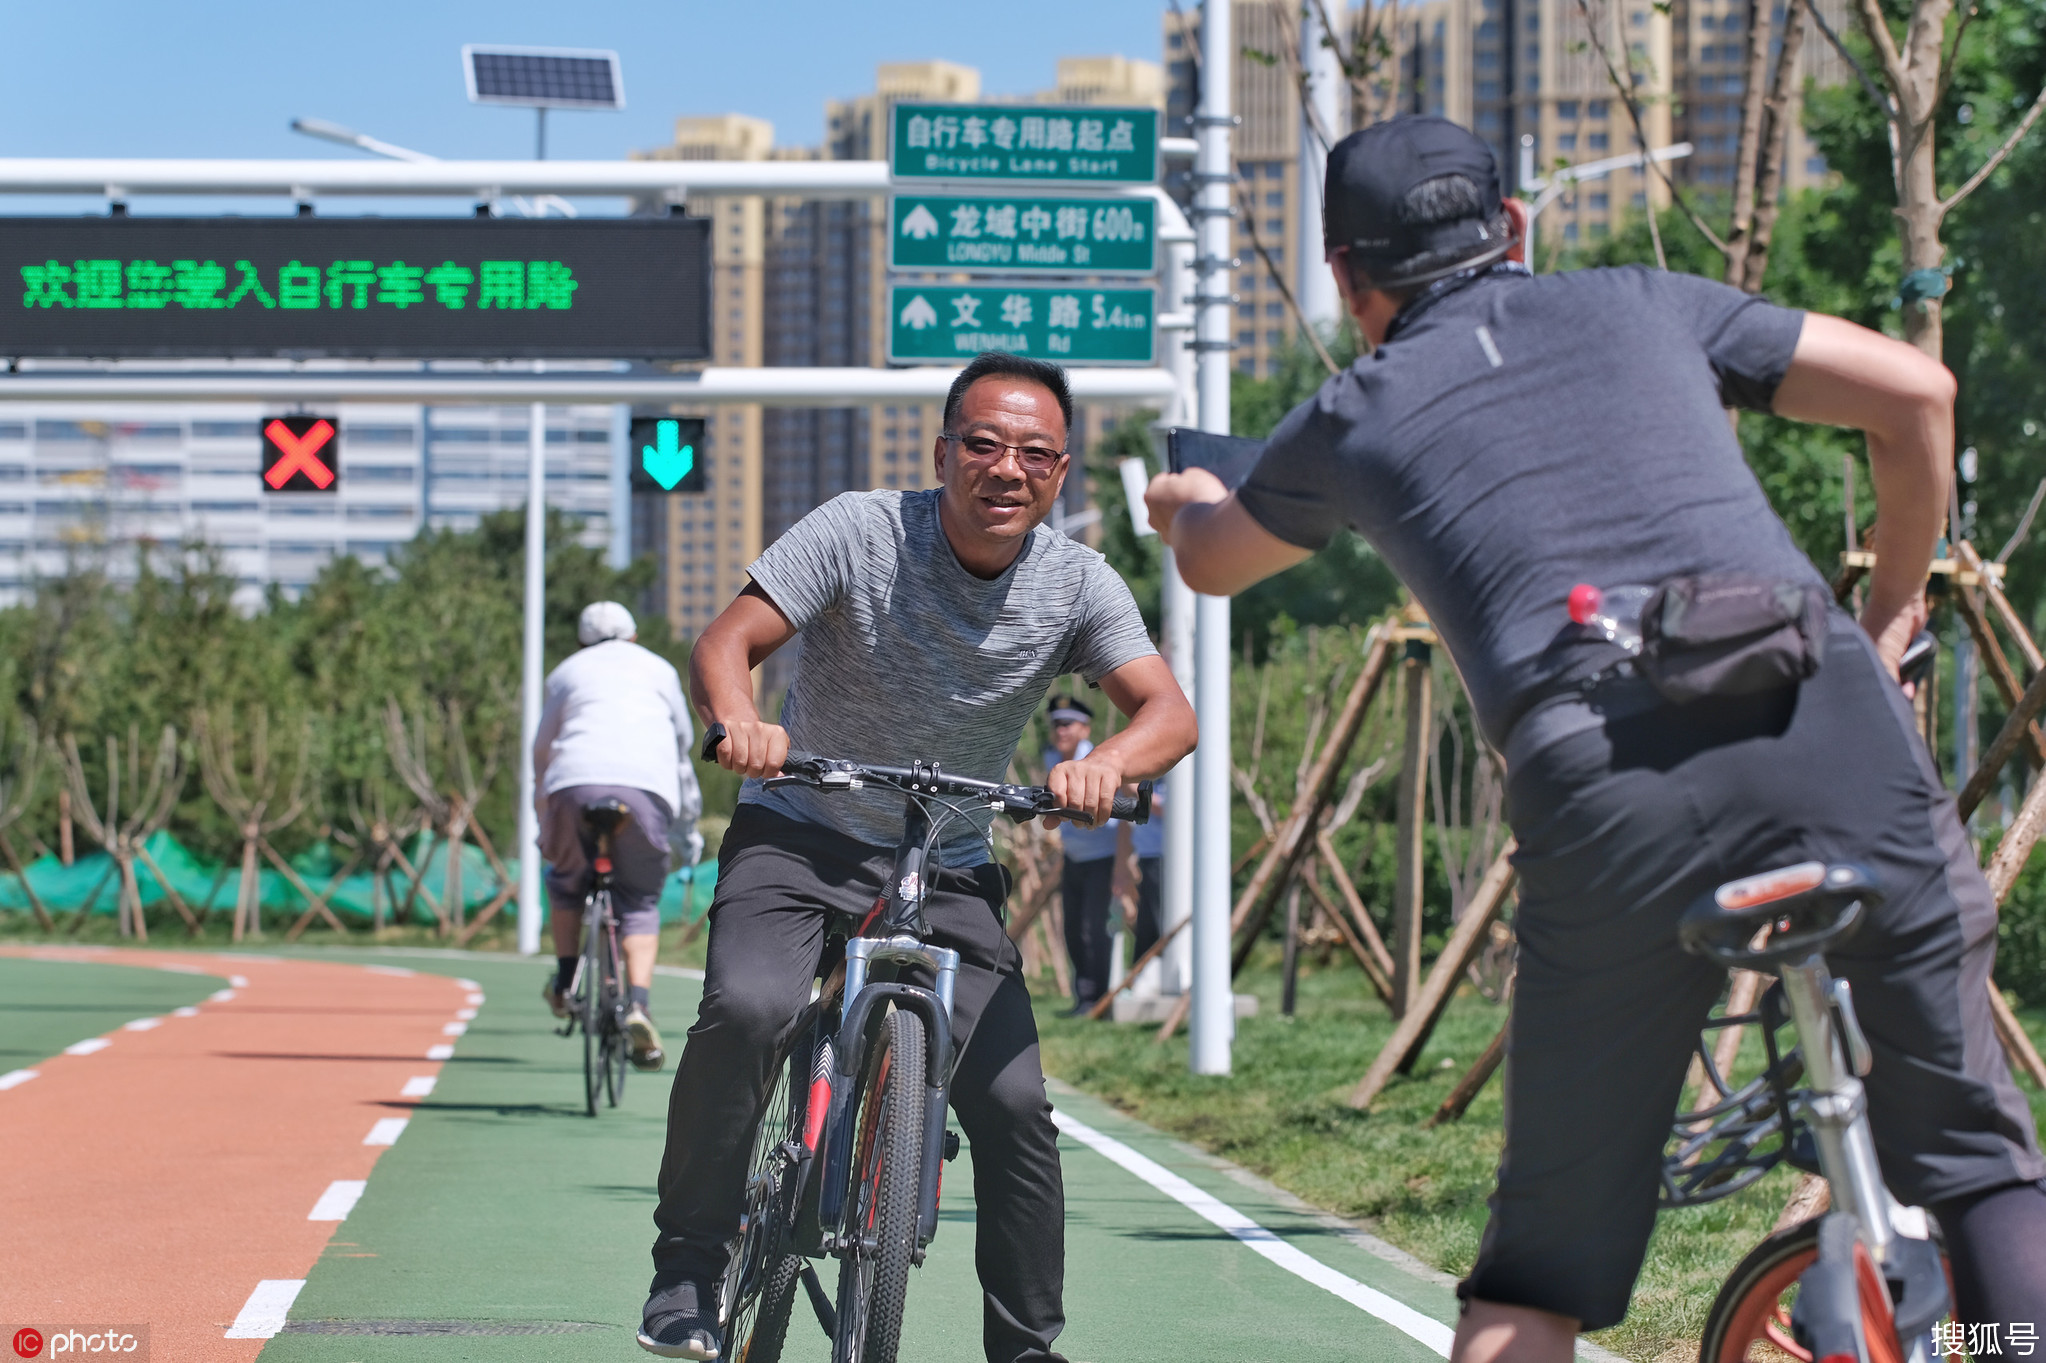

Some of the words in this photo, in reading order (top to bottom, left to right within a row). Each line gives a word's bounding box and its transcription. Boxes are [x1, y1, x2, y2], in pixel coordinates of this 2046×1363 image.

[907, 114, 1135, 151] 自行车专用路起点
[925, 154, 1000, 172] Bicycle
[1009, 156, 1058, 173] Lane
[1068, 157, 1119, 174] Start
[949, 204, 1088, 240] 龙域中街
[947, 242, 1012, 262] LONGYU
[1018, 243, 1067, 263] Middle
[1072, 244, 1091, 264] St
[951, 294, 1081, 329] 文华路
[953, 332, 1029, 352] WENHUA
[1047, 333, 1071, 353] Rd
